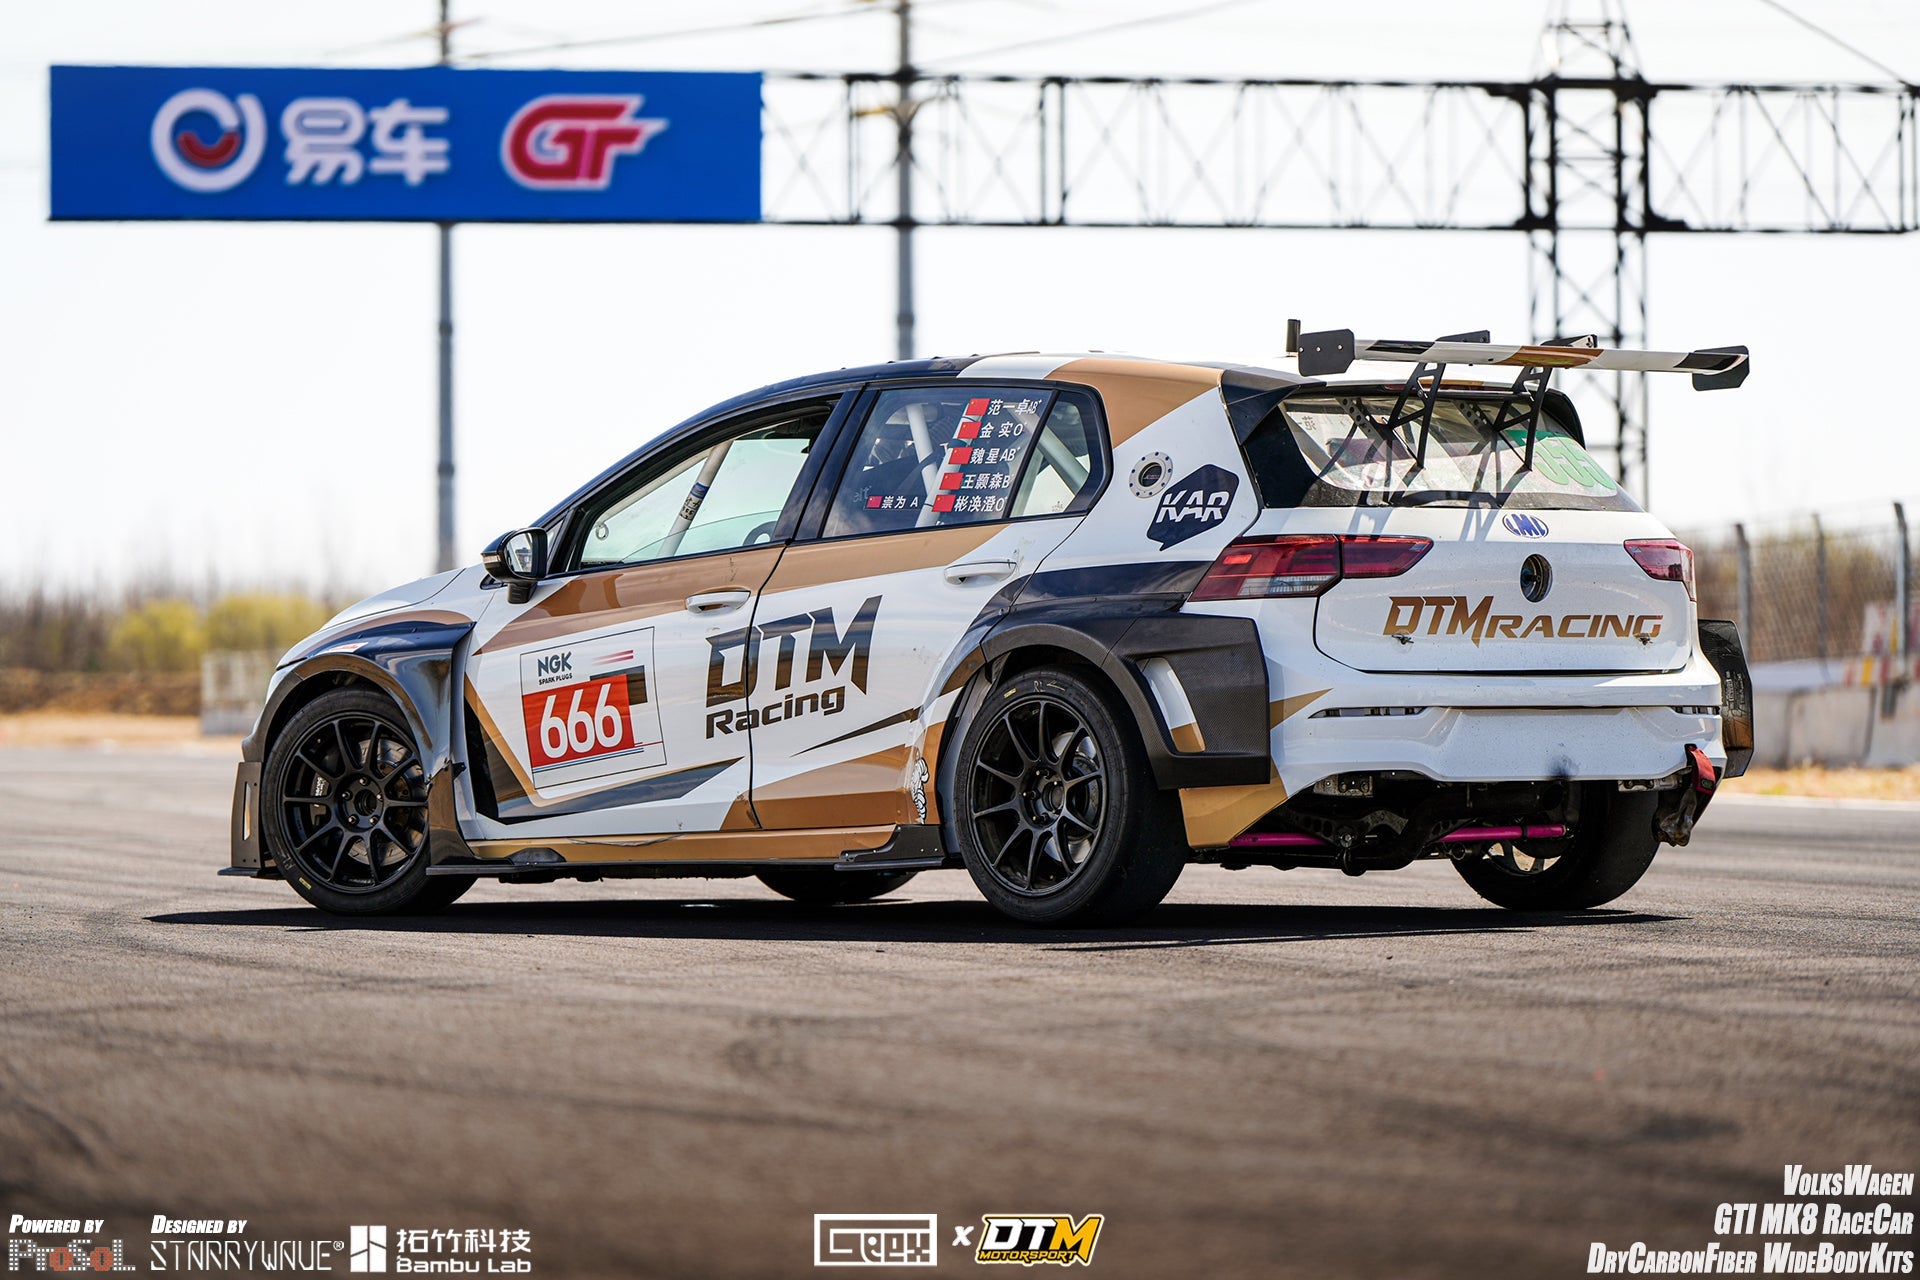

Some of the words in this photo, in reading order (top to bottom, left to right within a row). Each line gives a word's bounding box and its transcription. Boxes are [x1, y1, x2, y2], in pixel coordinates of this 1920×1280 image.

[281, 97, 449, 186] 易车
[1156, 489, 1230, 523] KAR
[537, 651, 572, 677] NGK
[705, 594, 883, 708] DTM
[538, 676, 556, 686] SPARK
[556, 673, 573, 682] PLUGS
[539, 684, 623, 759] 666
[706, 686, 845, 739] Racing
